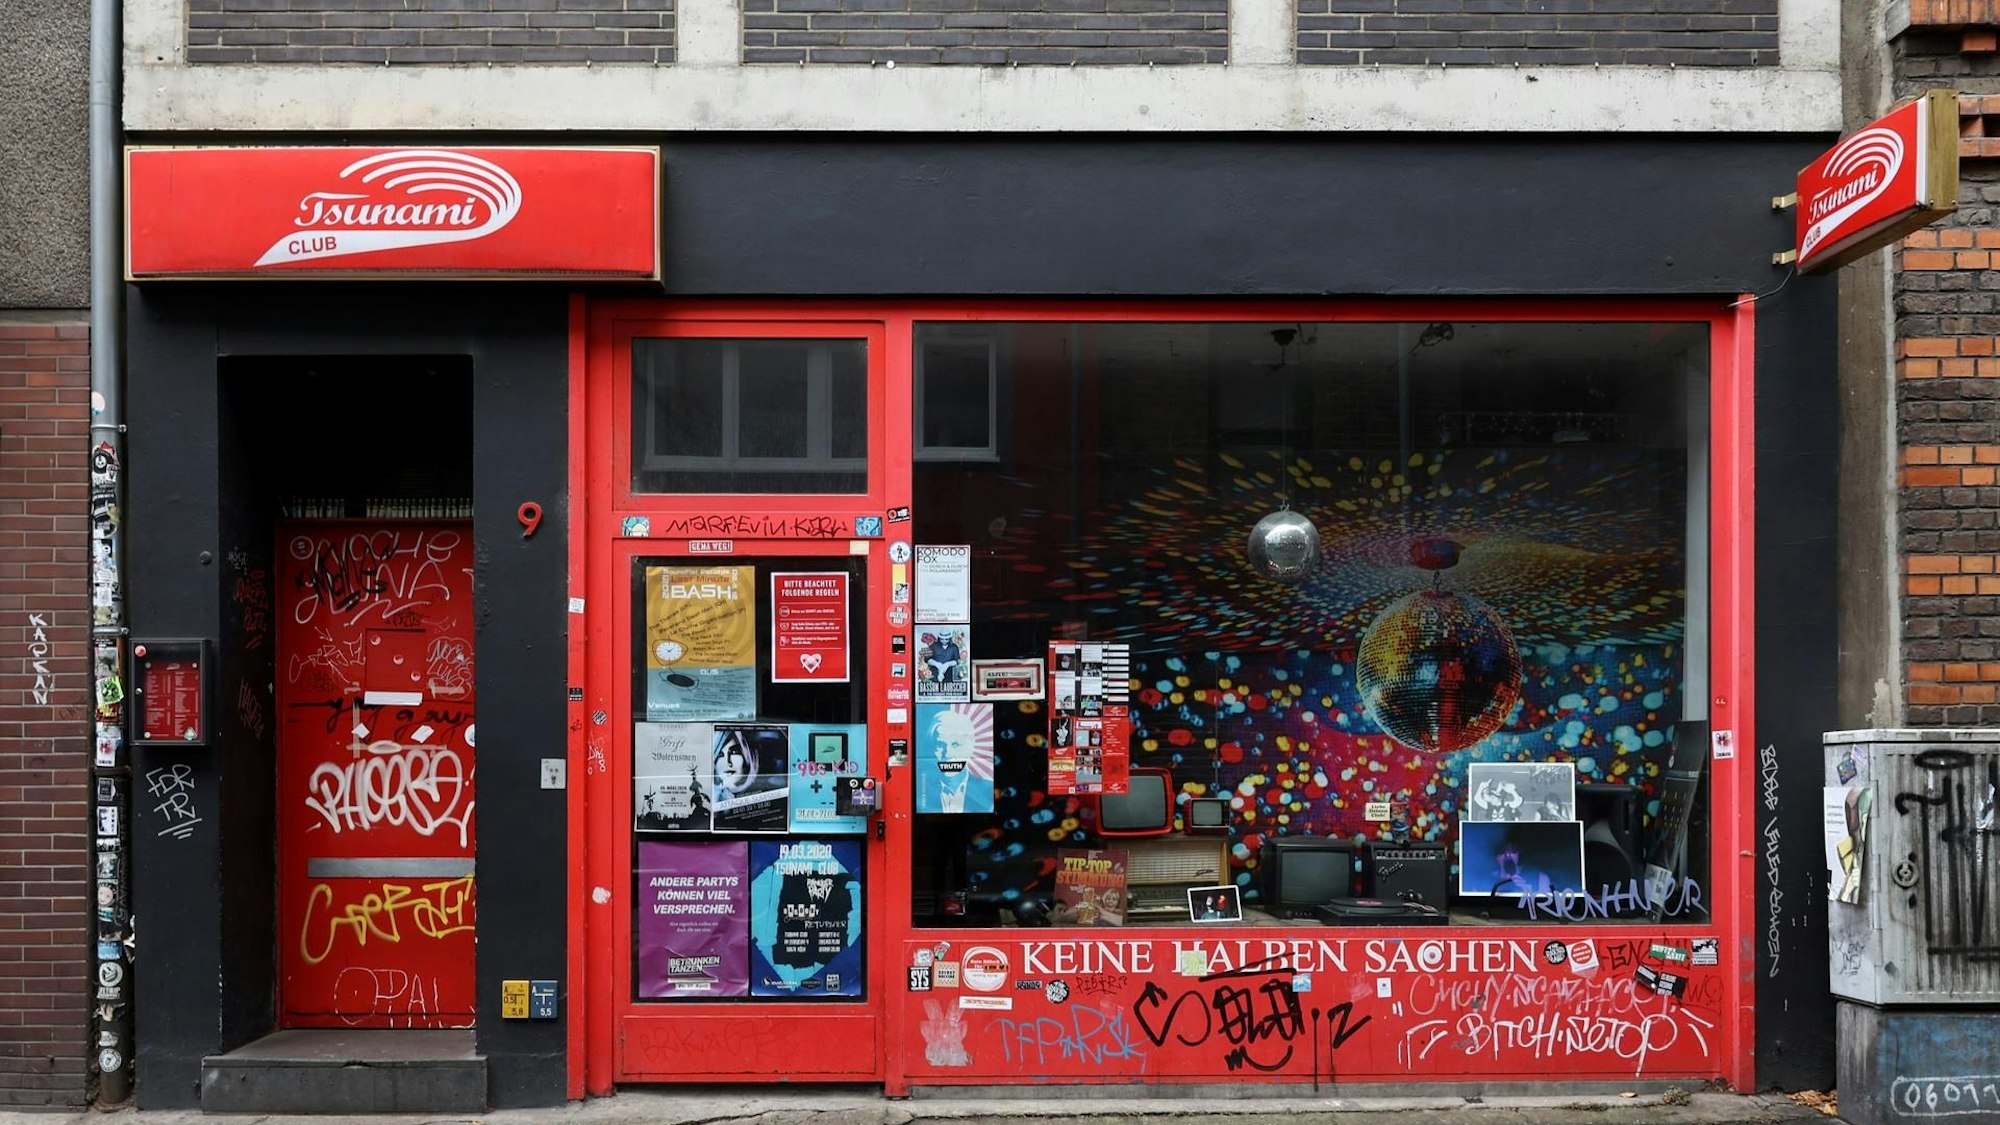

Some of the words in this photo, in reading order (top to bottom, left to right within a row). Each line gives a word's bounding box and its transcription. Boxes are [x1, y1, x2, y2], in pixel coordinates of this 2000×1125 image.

[1808, 163, 1879, 224] Tsunami
[294, 192, 477, 227] Tsunami
[1805, 227, 1822, 248] CLUB
[288, 236, 337, 255] CLUB
[517, 501, 543, 536] 9
[917, 547, 966, 557] KOMODO
[917, 556, 938, 564] FOX
[671, 584, 732, 599] BASH
[784, 580, 802, 588] BITTE
[804, 580, 836, 588] BEACHTET
[781, 589, 814, 597] FOLGENDE
[815, 588, 840, 597] REGELN
[779, 844, 832, 859] 19.03.2020
[776, 861, 813, 876] TSUNAMI
[818, 861, 839, 875] CLUB
[1064, 857, 1113, 873] TIP-TOP
[650, 876, 695, 887] ANDERE
[697, 876, 739, 887] PARTYS
[1057, 870, 1126, 888] STIMMUNG
[657, 889, 704, 901] KÖNNEN
[706, 890, 731, 900] VIEL
[653, 904, 735, 914] VERSPRECHEN.
[670, 956, 721, 967] BETRUNKEN
[1020, 941, 1155, 974] KEINE
[1171, 940, 1348, 974] HALBEN
[1365, 940, 1538, 974] SACHEN
[671, 965, 702, 973] TANZEN
[911, 969, 929, 988] SYS
[532, 985, 537, 993] A
